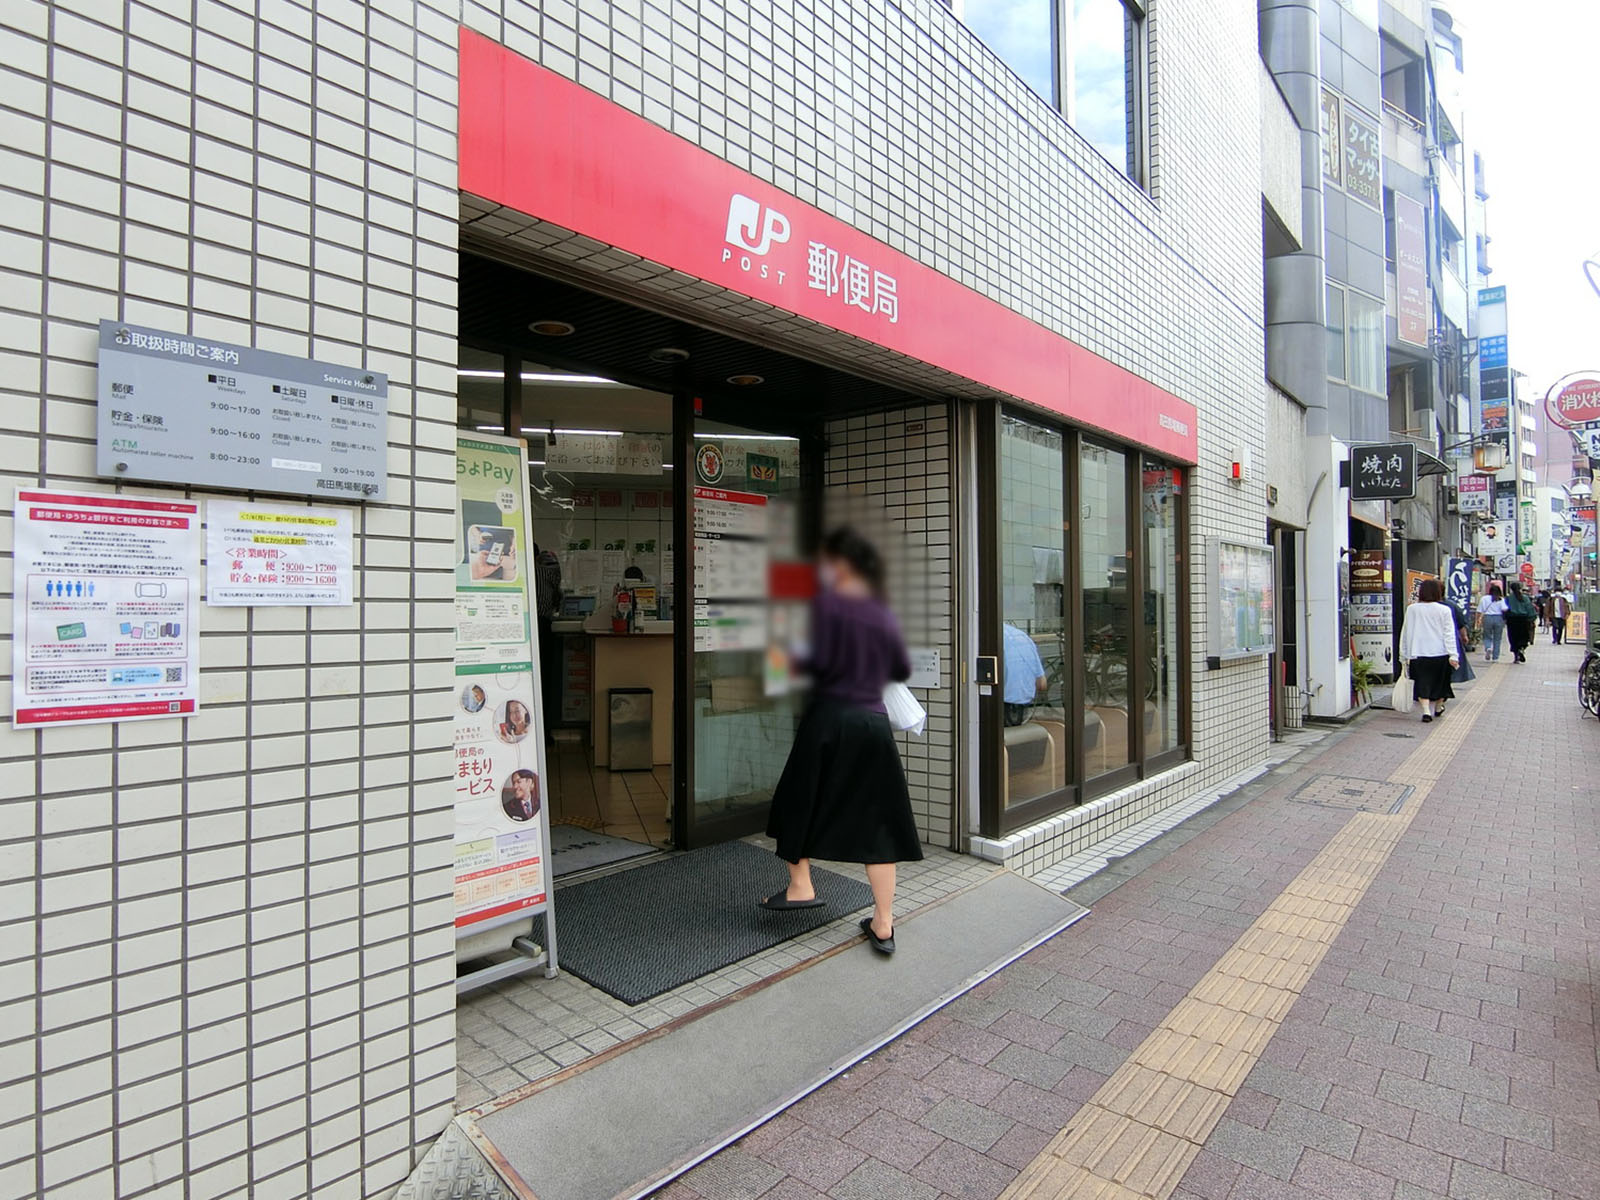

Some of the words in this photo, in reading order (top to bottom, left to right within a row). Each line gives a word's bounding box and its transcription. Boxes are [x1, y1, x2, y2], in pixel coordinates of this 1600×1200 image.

[725, 193, 791, 256] JP
[722, 248, 786, 286] POST
[807, 239, 899, 324] 郵便局
[115, 328, 240, 365] お取扱時間ご案内
[111, 382, 134, 396] 郵便
[323, 374, 353, 387] Service
[353, 379, 377, 392] Hours
[111, 409, 164, 427] 貯金・保険
[112, 439, 138, 450] ATM
[1360, 453, 1403, 474] 焼肉
[36, 510, 181, 527] 郵便局・ゆうちょ銀行をご利用のお客さまへ
